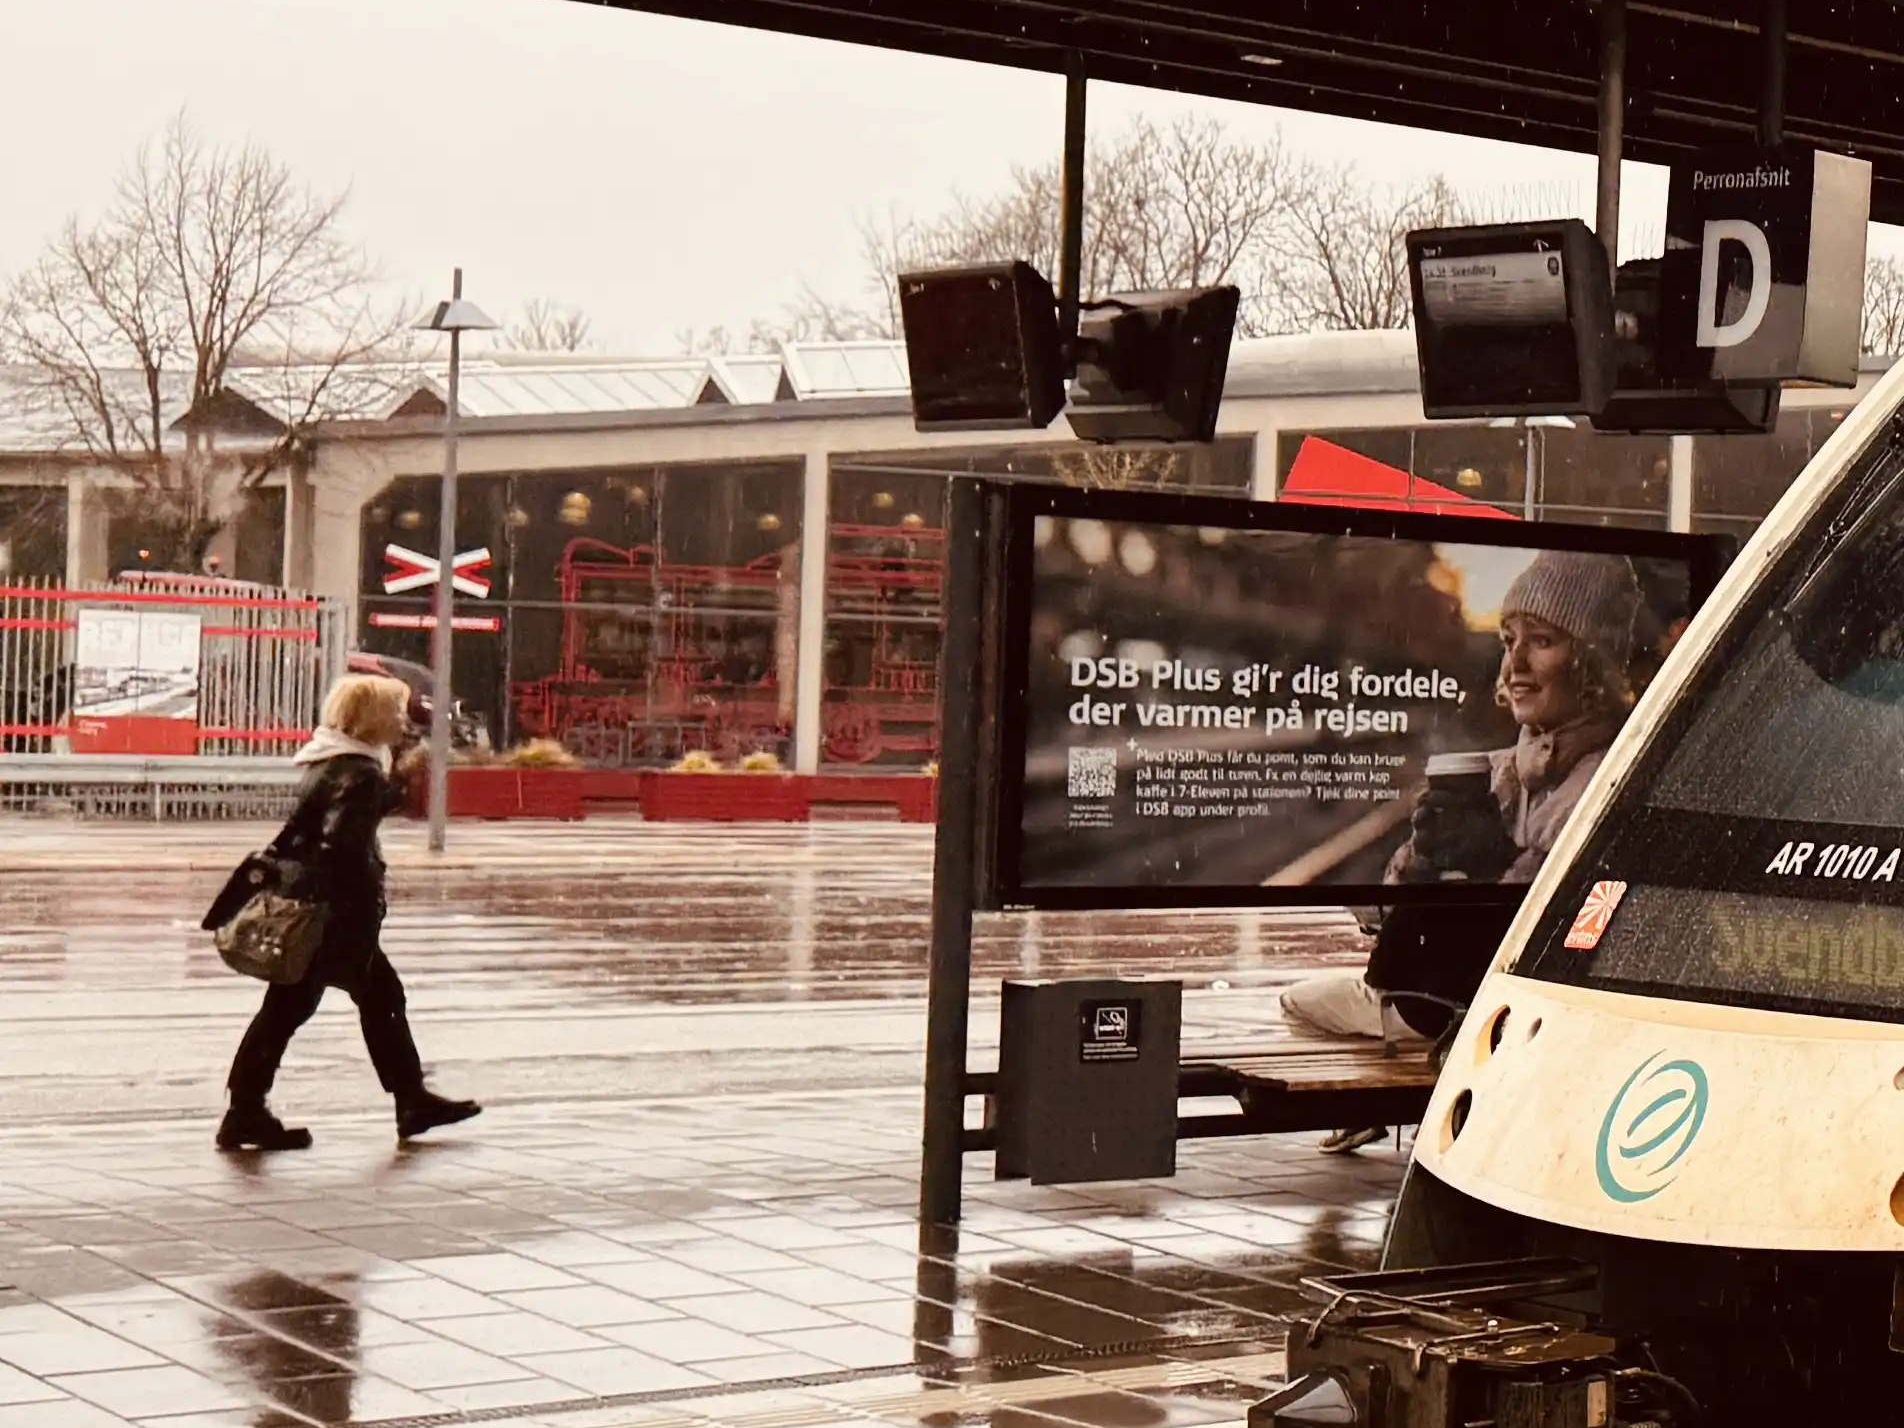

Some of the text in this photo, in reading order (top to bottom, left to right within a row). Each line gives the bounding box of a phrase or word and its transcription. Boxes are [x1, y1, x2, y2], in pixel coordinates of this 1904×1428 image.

[1693, 166, 1791, 191] Perronafsnit
[1696, 219, 1772, 348] D
[1070, 658, 1140, 689] DSB
[1151, 659, 1221, 692] Plus
[1291, 663, 1340, 701] dig
[1349, 666, 1468, 704] fordele,
[1068, 694, 1409, 737] der varmer på rejsen
[1765, 841, 1902, 882] AR 1010 A
